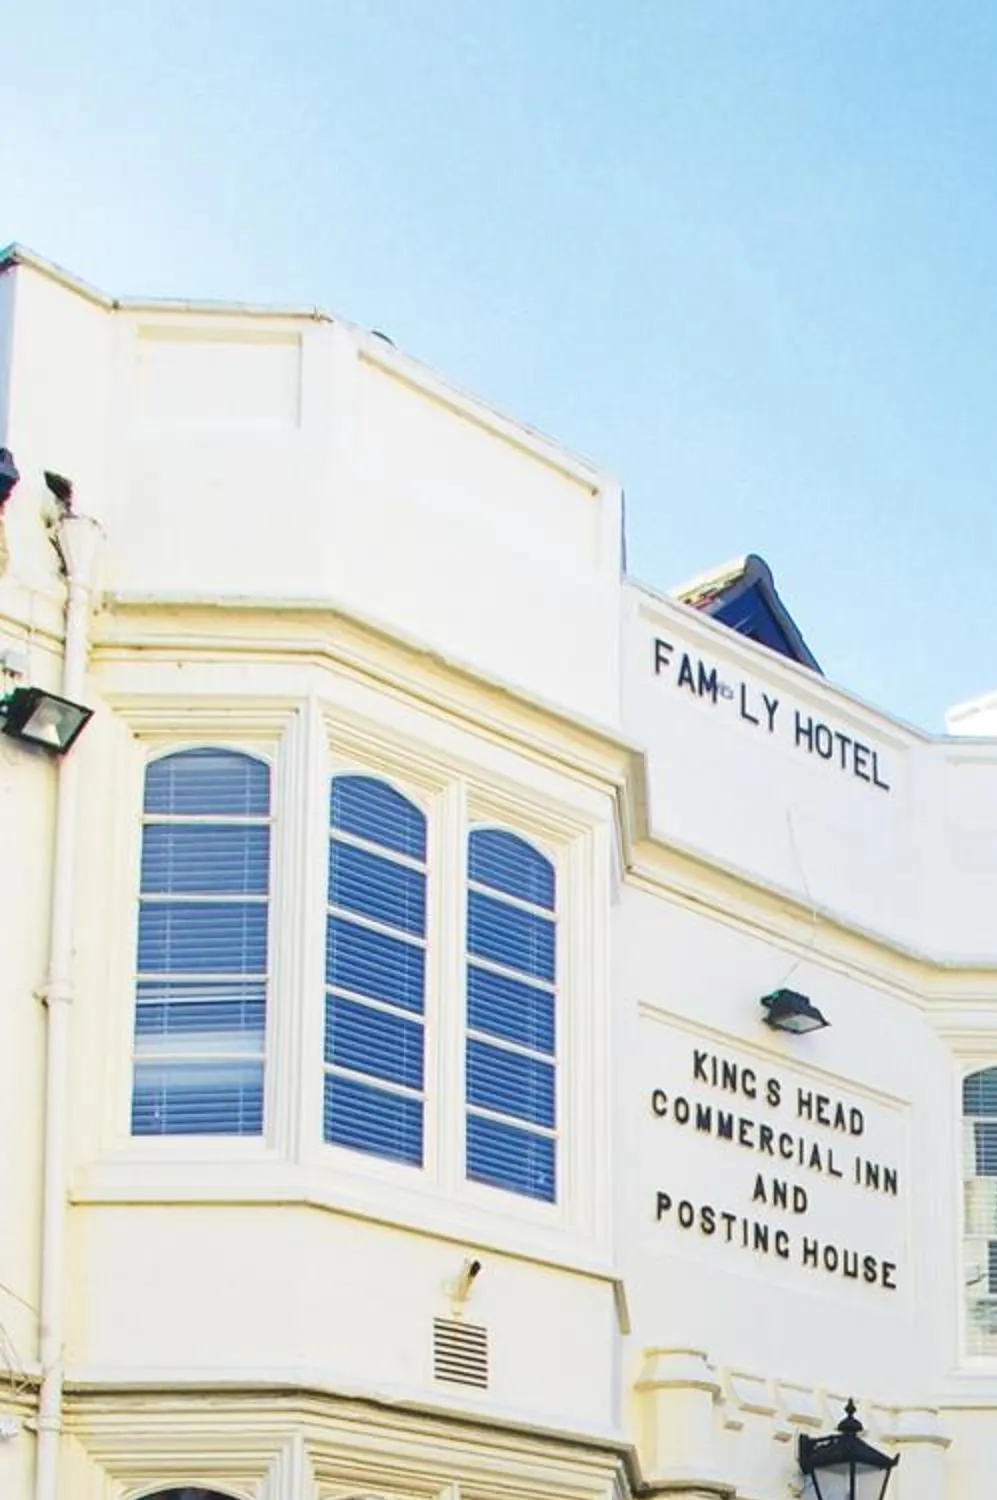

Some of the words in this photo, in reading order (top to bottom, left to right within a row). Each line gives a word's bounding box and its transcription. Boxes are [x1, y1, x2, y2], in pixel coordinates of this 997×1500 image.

[653, 637, 780, 734] FAMLY
[794, 709, 891, 792] HOTEL
[651, 1088, 844, 1178] COMMERCIAL
[855, 1156, 899, 1197] INN
[797, 1087, 865, 1137] HEAD
[655, 1191, 790, 1258] POSTING
[802, 1236, 898, 1290] HOUSE
[752, 1173, 809, 1214] AND
